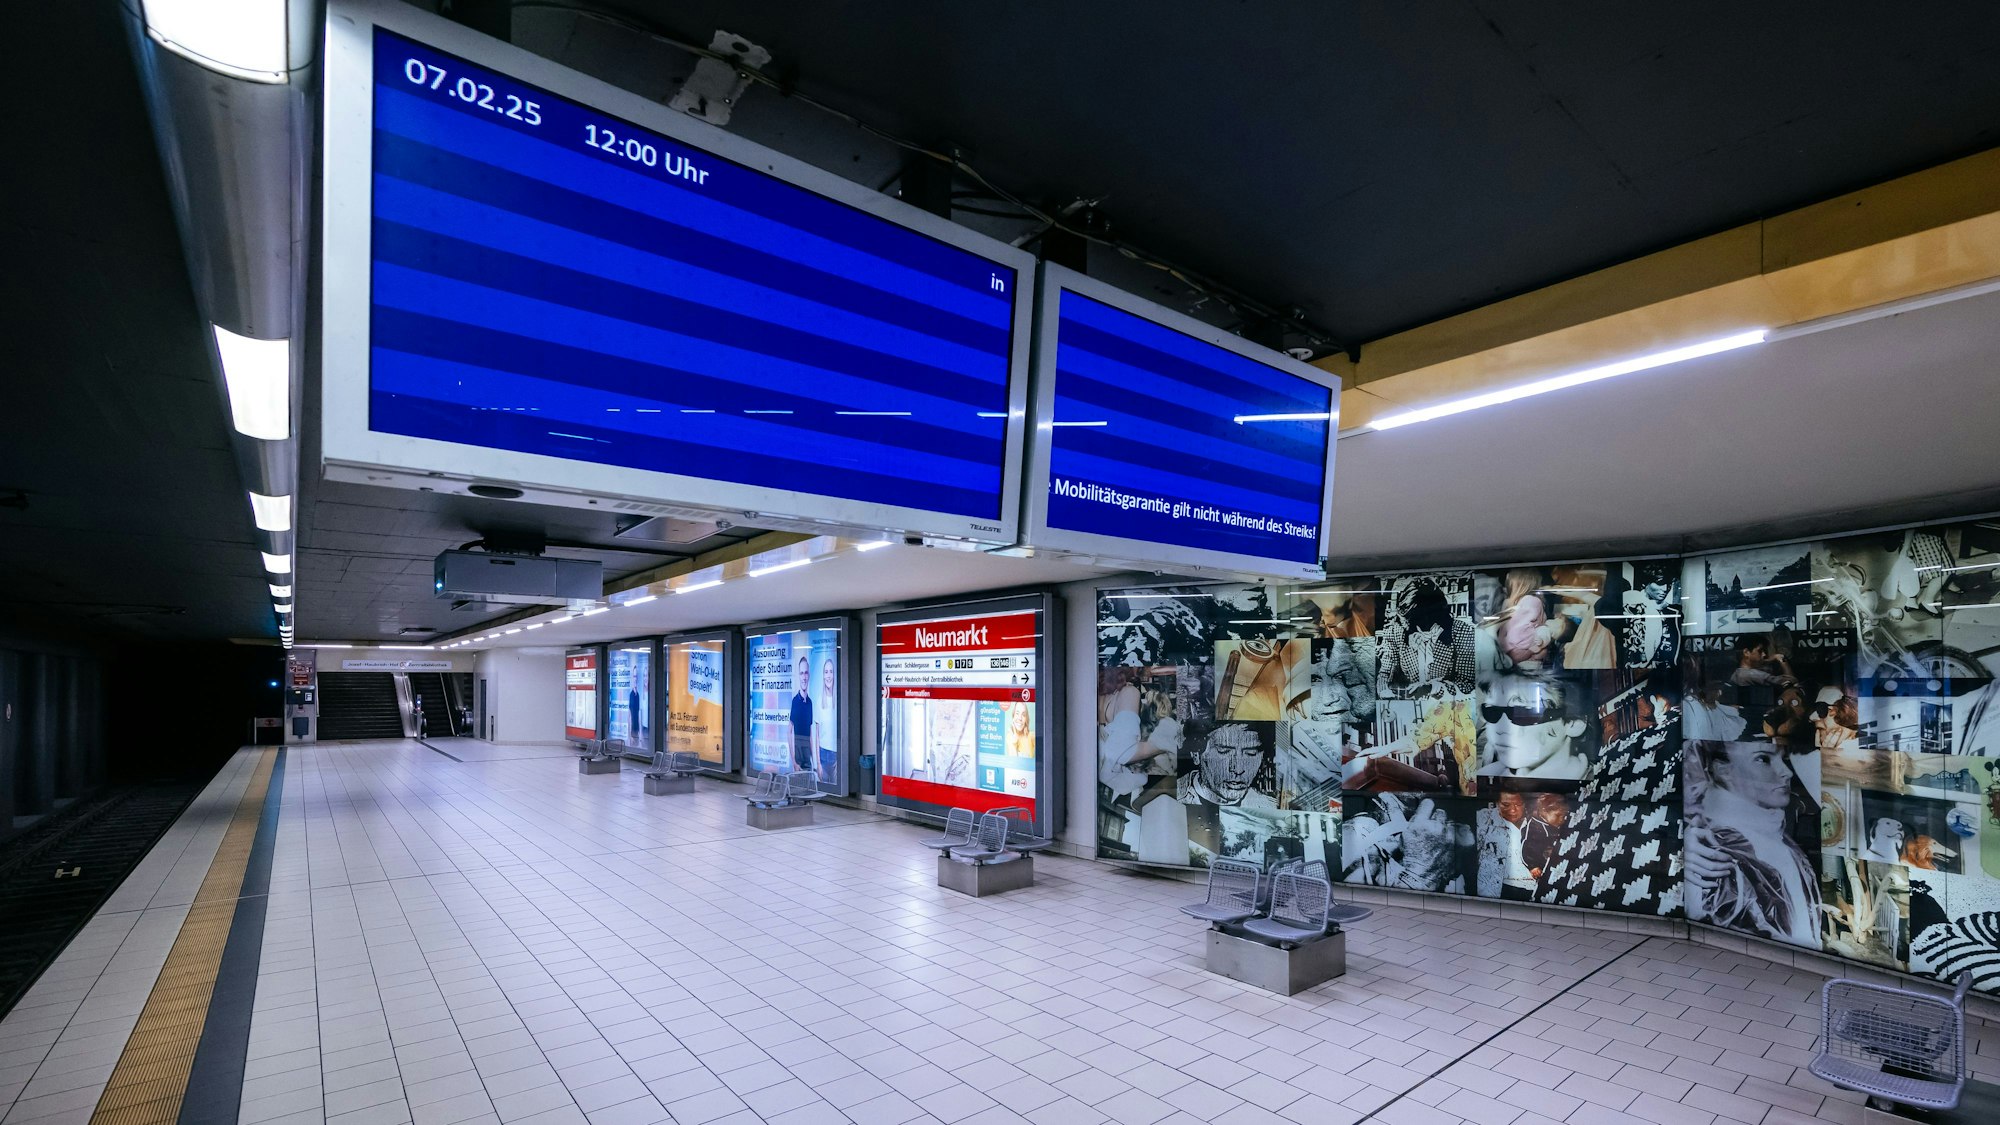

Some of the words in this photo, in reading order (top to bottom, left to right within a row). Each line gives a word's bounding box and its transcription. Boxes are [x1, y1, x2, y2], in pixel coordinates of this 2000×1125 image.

[404, 58, 542, 126] 07.02.25
[584, 124, 657, 167] 12:00
[665, 152, 709, 185] Uhr
[991, 272, 1004, 292] in
[1055, 478, 1171, 514] Mobilitätsgarantie
[1173, 502, 1192, 519] gilt
[1194, 506, 1220, 523] nicht
[1222, 511, 1265, 531] während
[1266, 518, 1283, 533] des
[1284, 522, 1317, 539] Streiks!
[970, 523, 1002, 533] TELESTE
[915, 623, 988, 649] Neumarkt
[690, 663, 720, 681] Wahl-O-Mat
[753, 663, 766, 674] oder
[768, 662, 792, 674] Studium
[690, 680, 712, 693] gespielt?
[762, 679, 792, 690] Finanzamt
